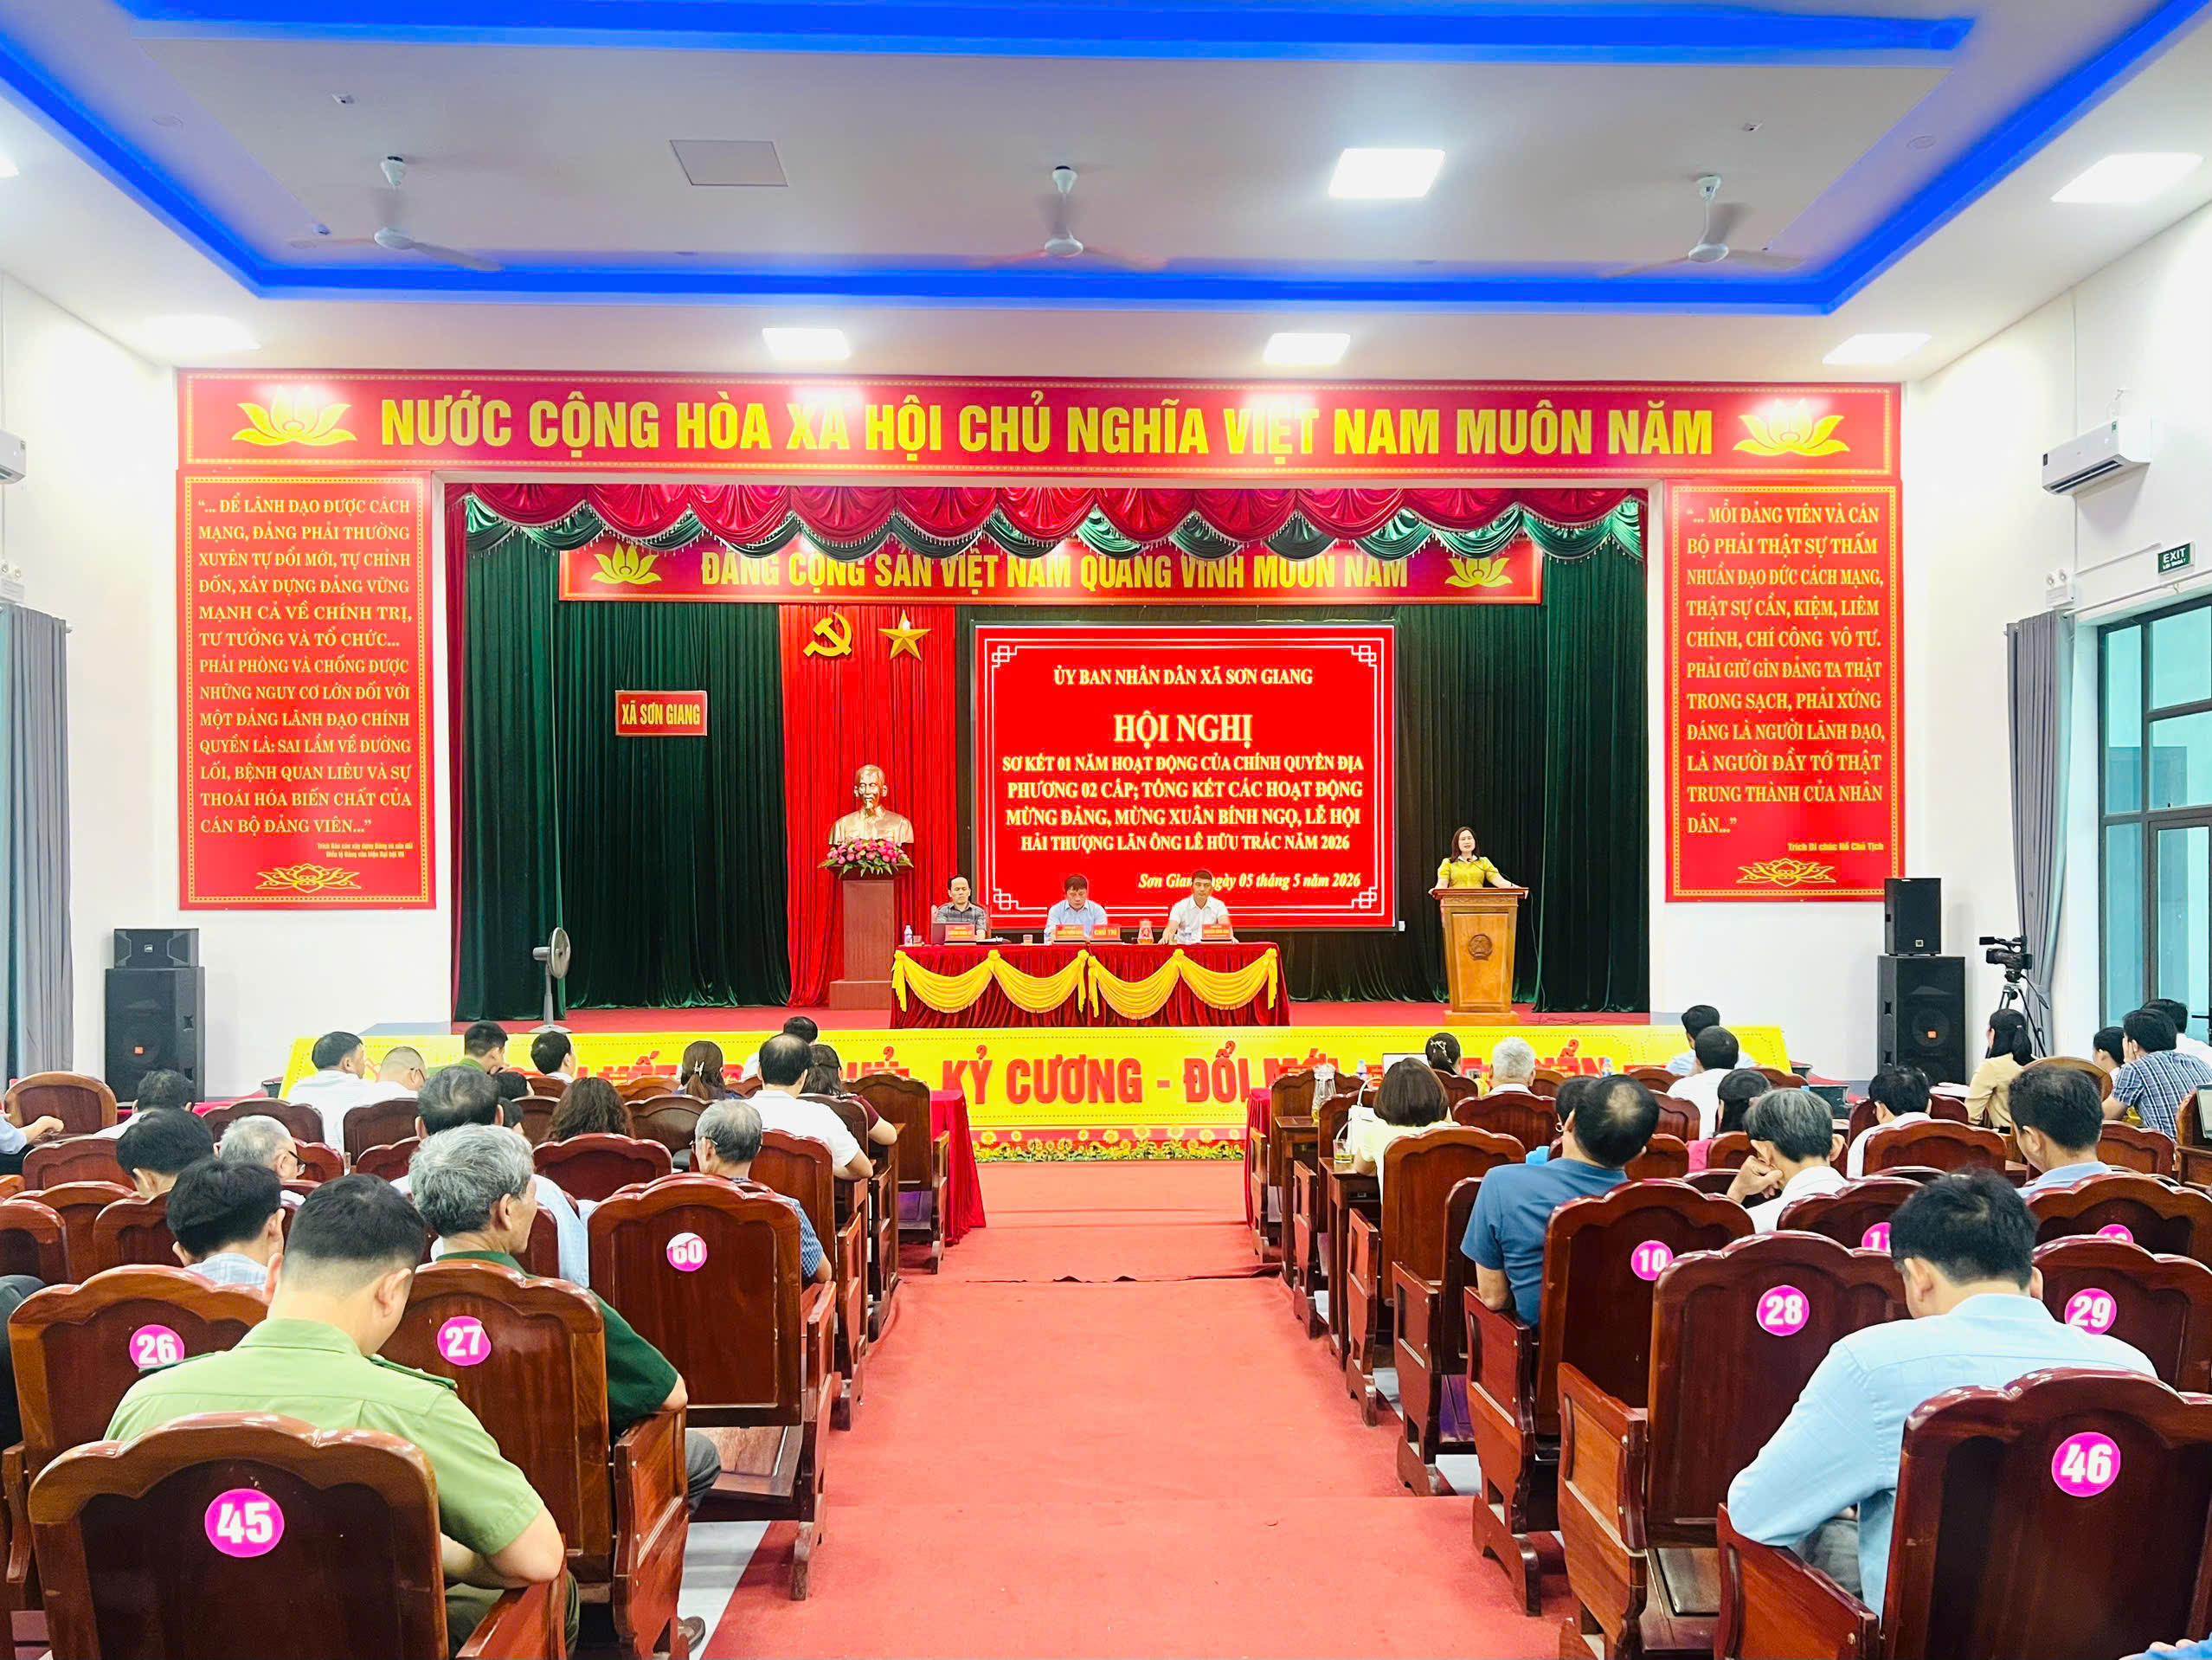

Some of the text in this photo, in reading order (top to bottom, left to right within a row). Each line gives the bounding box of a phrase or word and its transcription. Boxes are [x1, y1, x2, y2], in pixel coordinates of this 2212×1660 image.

[382, 389, 511, 447] NƯỚC
[530, 392, 659, 458] CỘNG
[677, 390, 771, 449] HÒA
[866, 395, 942, 461] HỘI
[959, 389, 1051, 452] CHỦ
[1067, 398, 1208, 454] NGHĨA
[1334, 409, 1440, 454] NAM
[1456, 401, 1591, 454] MUÔN
[1609, 400, 1713, 455] NĂM
[253, 521, 297, 539] ĐẢNG
[302, 521, 338, 540] PHẢI
[343, 522, 409, 540] THƯỜNG
[2164, 548, 2186, 563] EXIT
[1007, 555, 1071, 588] NAM
[1081, 555, 1171, 591] QUANG
[1180, 555, 1244, 588] VINH
[199, 600, 412, 623] MẠNH CẢ VỀ CHÍNH TRỊ,
[1687, 626, 1881, 649] CHÍNH, CHÍ CÔNG VÔ TƯ.
[200, 654, 408, 676] PHẢI PHÒNG VÀ CHỐNG ĐƯỢC
[1054, 665, 1313, 685] ỦY BAN NHÂN DÂN XÃ SƠN GIANG
[1687, 686, 1881, 713] TRONG SẠCH, PHẢI XỨNG
[201, 708, 408, 730] MỘT ĐẢNG LÃNH ĐẠO CHÍNH
[622, 700, 700, 725] XÃ SƠN GIANG
[1114, 710, 1253, 750] HỘI NGHỊ
[1002, 756, 1023, 771] SƠ
[1058, 756, 1071, 771] 01
[1075, 753, 1109, 771] NĂM
[1111, 756, 1153, 774] HOẠT
[1156, 755, 1198, 774] ĐỘNG
[1200, 752, 1231, 770] CỦA
[1233, 752, 1281, 770] CHÍNH
[1337, 756, 1364, 774] ĐỊA
[1007, 780, 1078, 798] PHƯƠNG
[1081, 782, 1097, 798] 02
[1228, 777, 1263, 797] CÁC
[1266, 781, 1312, 801] HOẠT
[1315, 779, 1362, 801] ĐỘNG
[1687, 779, 1882, 802] TRUNG THÀNH CỦA NHÂN
[1006, 806, 1058, 826] MỪNG
[1115, 805, 1166, 826] MỪNG
[1168, 804, 1214, 825] XUÂN
[1219, 805, 1258, 824] BÍNH
[1262, 808, 1302, 828] NGỌ,
[1329, 806, 1360, 828] HỘI
[1021, 831, 1350, 853] HẢI THƯỢNG LÃN ÔNG LÊ HỮU TRÁC NĂM 2026
[1138, 873, 1162, 888] Sơn
[1239, 872, 1254, 887] 05
[1256, 872, 1290, 891] tháng
[1293, 873, 1301, 887] 5
[1302, 873, 1329, 887] năm
[1332, 872, 1361, 888] 2026
[942, 1045, 993, 1104] KỶ
[1006, 1053, 1142, 1103] CƯƠNG
[1184, 1040, 1251, 1103] ĐỔI
[672, 1239, 703, 1264] 60
[1639, 1249, 1667, 1272] 10
[1765, 1295, 1802, 1325] 28
[2069, 1296, 2112, 1328] 29
[137, 1334, 177, 1364] 26
[446, 1325, 482, 1357] 27
[2061, 1444, 2112, 1483] 46
[217, 1502, 273, 1543] 45
